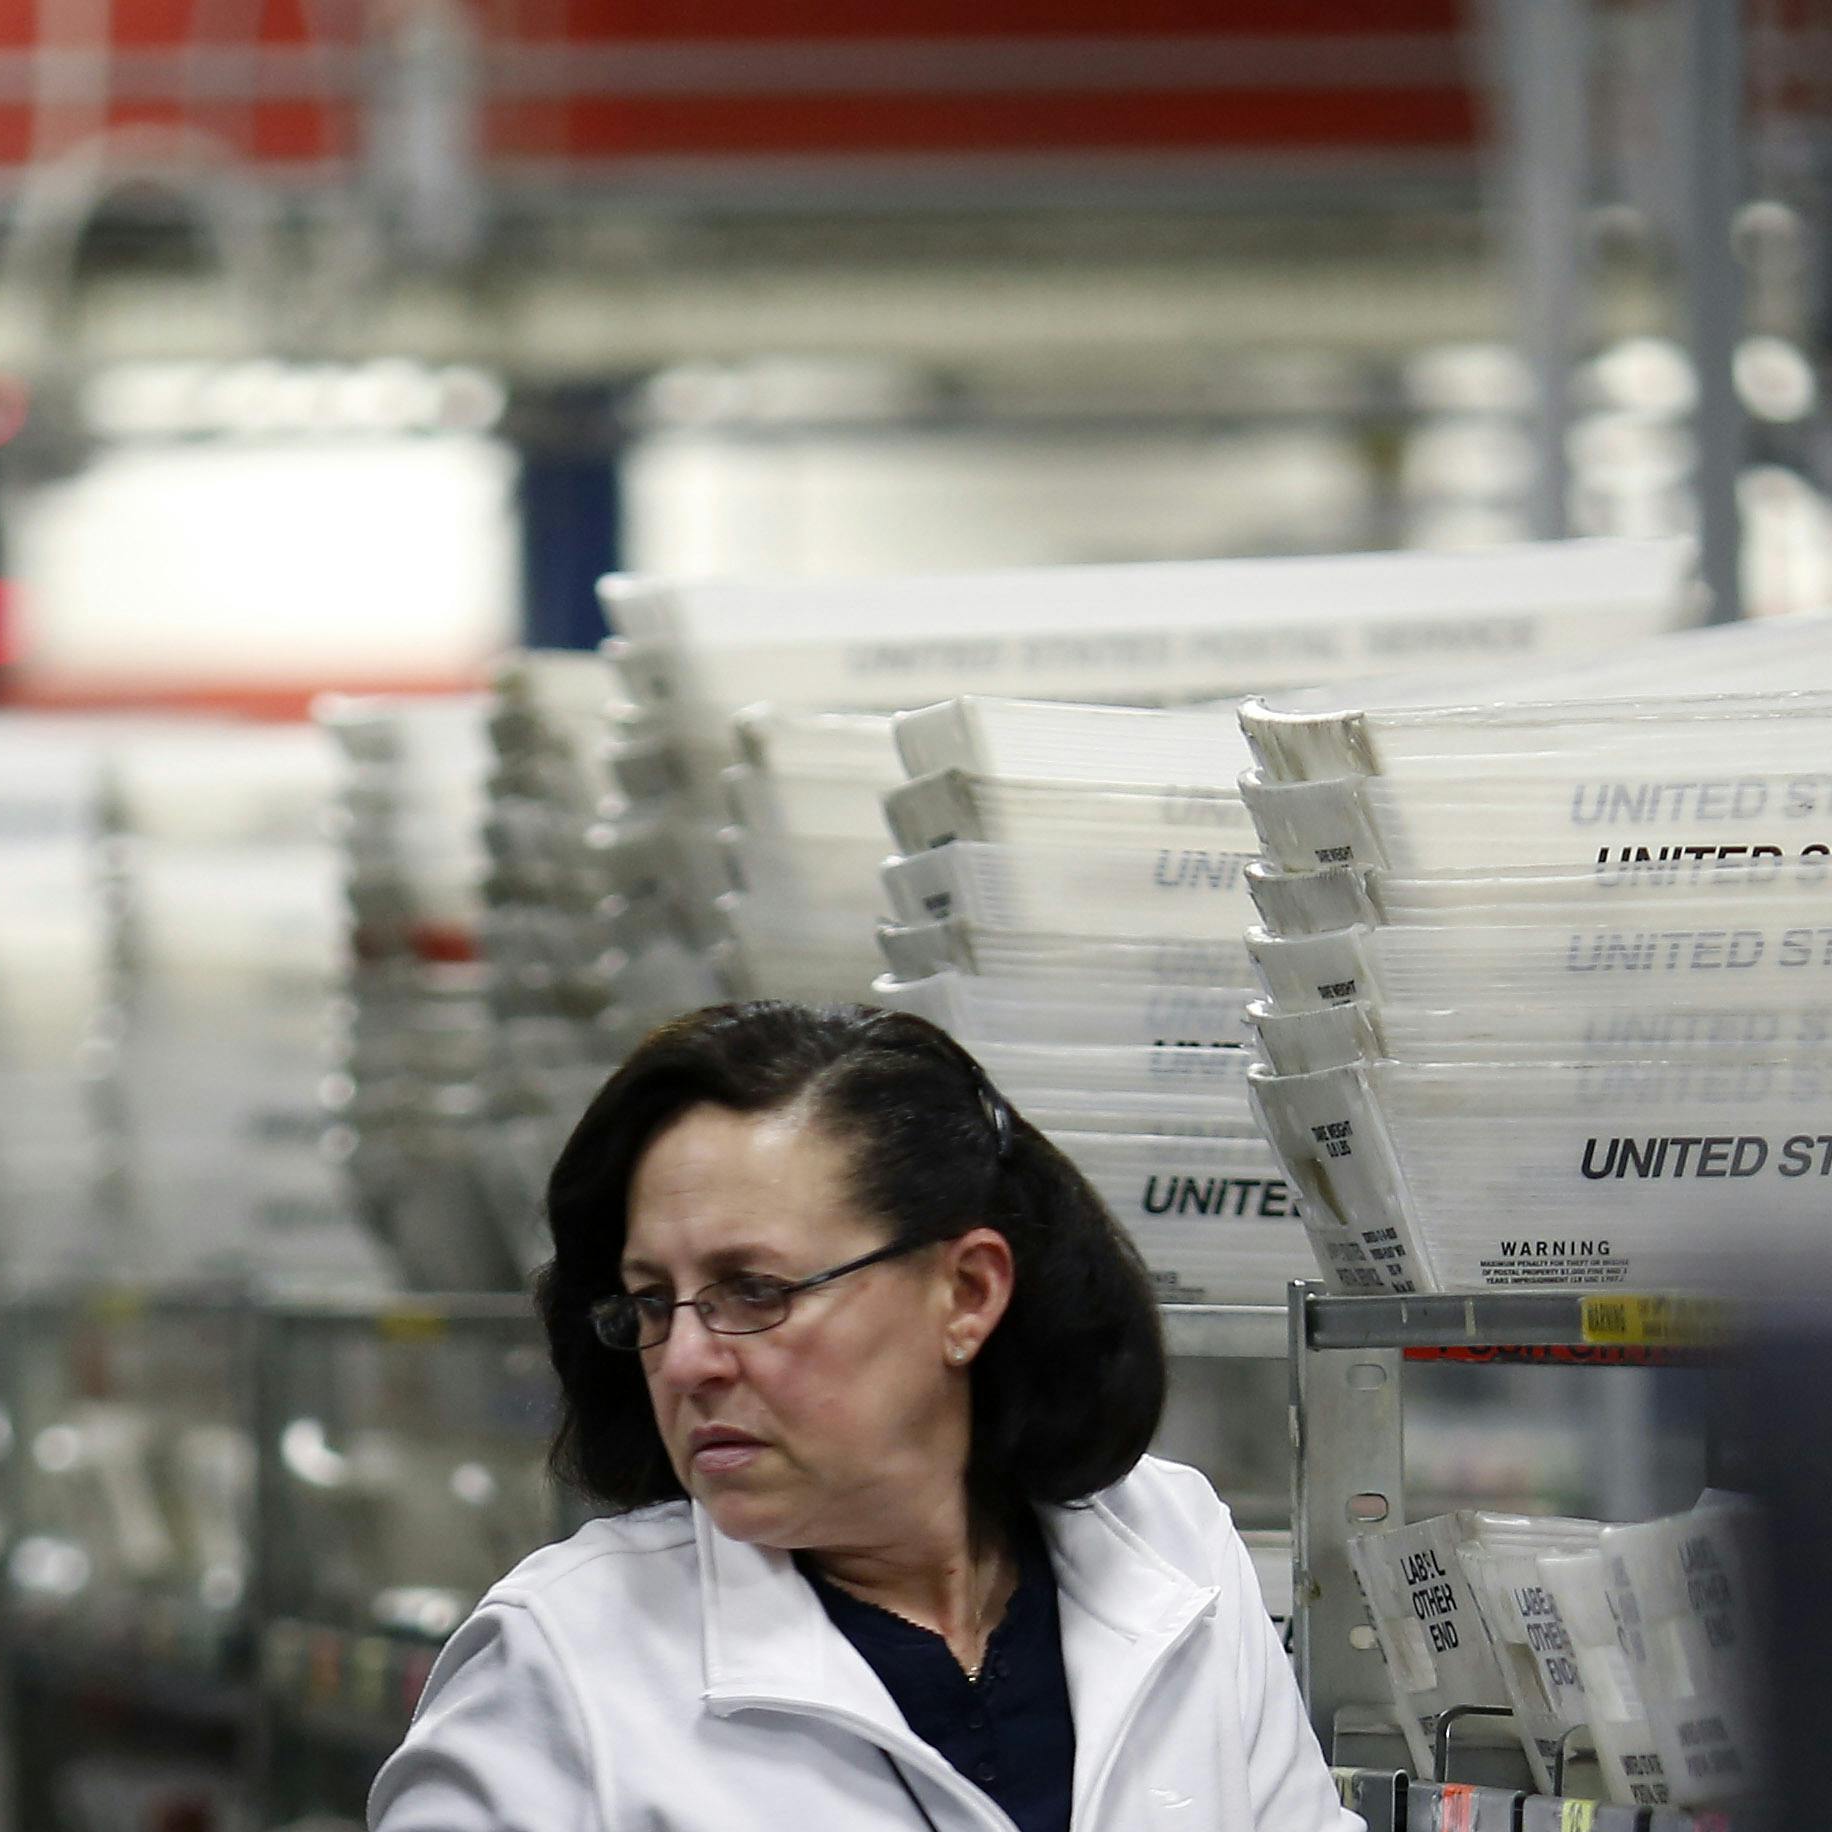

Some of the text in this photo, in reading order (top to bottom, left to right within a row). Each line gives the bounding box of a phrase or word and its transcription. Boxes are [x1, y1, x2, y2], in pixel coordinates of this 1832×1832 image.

[1570, 782, 1768, 826] UNITED
[1596, 845, 1784, 887] UNITED
[1566, 930, 1764, 971] UNITED
[1581, 1136, 1768, 1180] UNITED
[1144, 1175, 1301, 1218] UNITE
[1501, 1240, 1611, 1256] WARNING
[1412, 1583, 1458, 1620] OTHER
[1429, 1620, 1459, 1652] END
